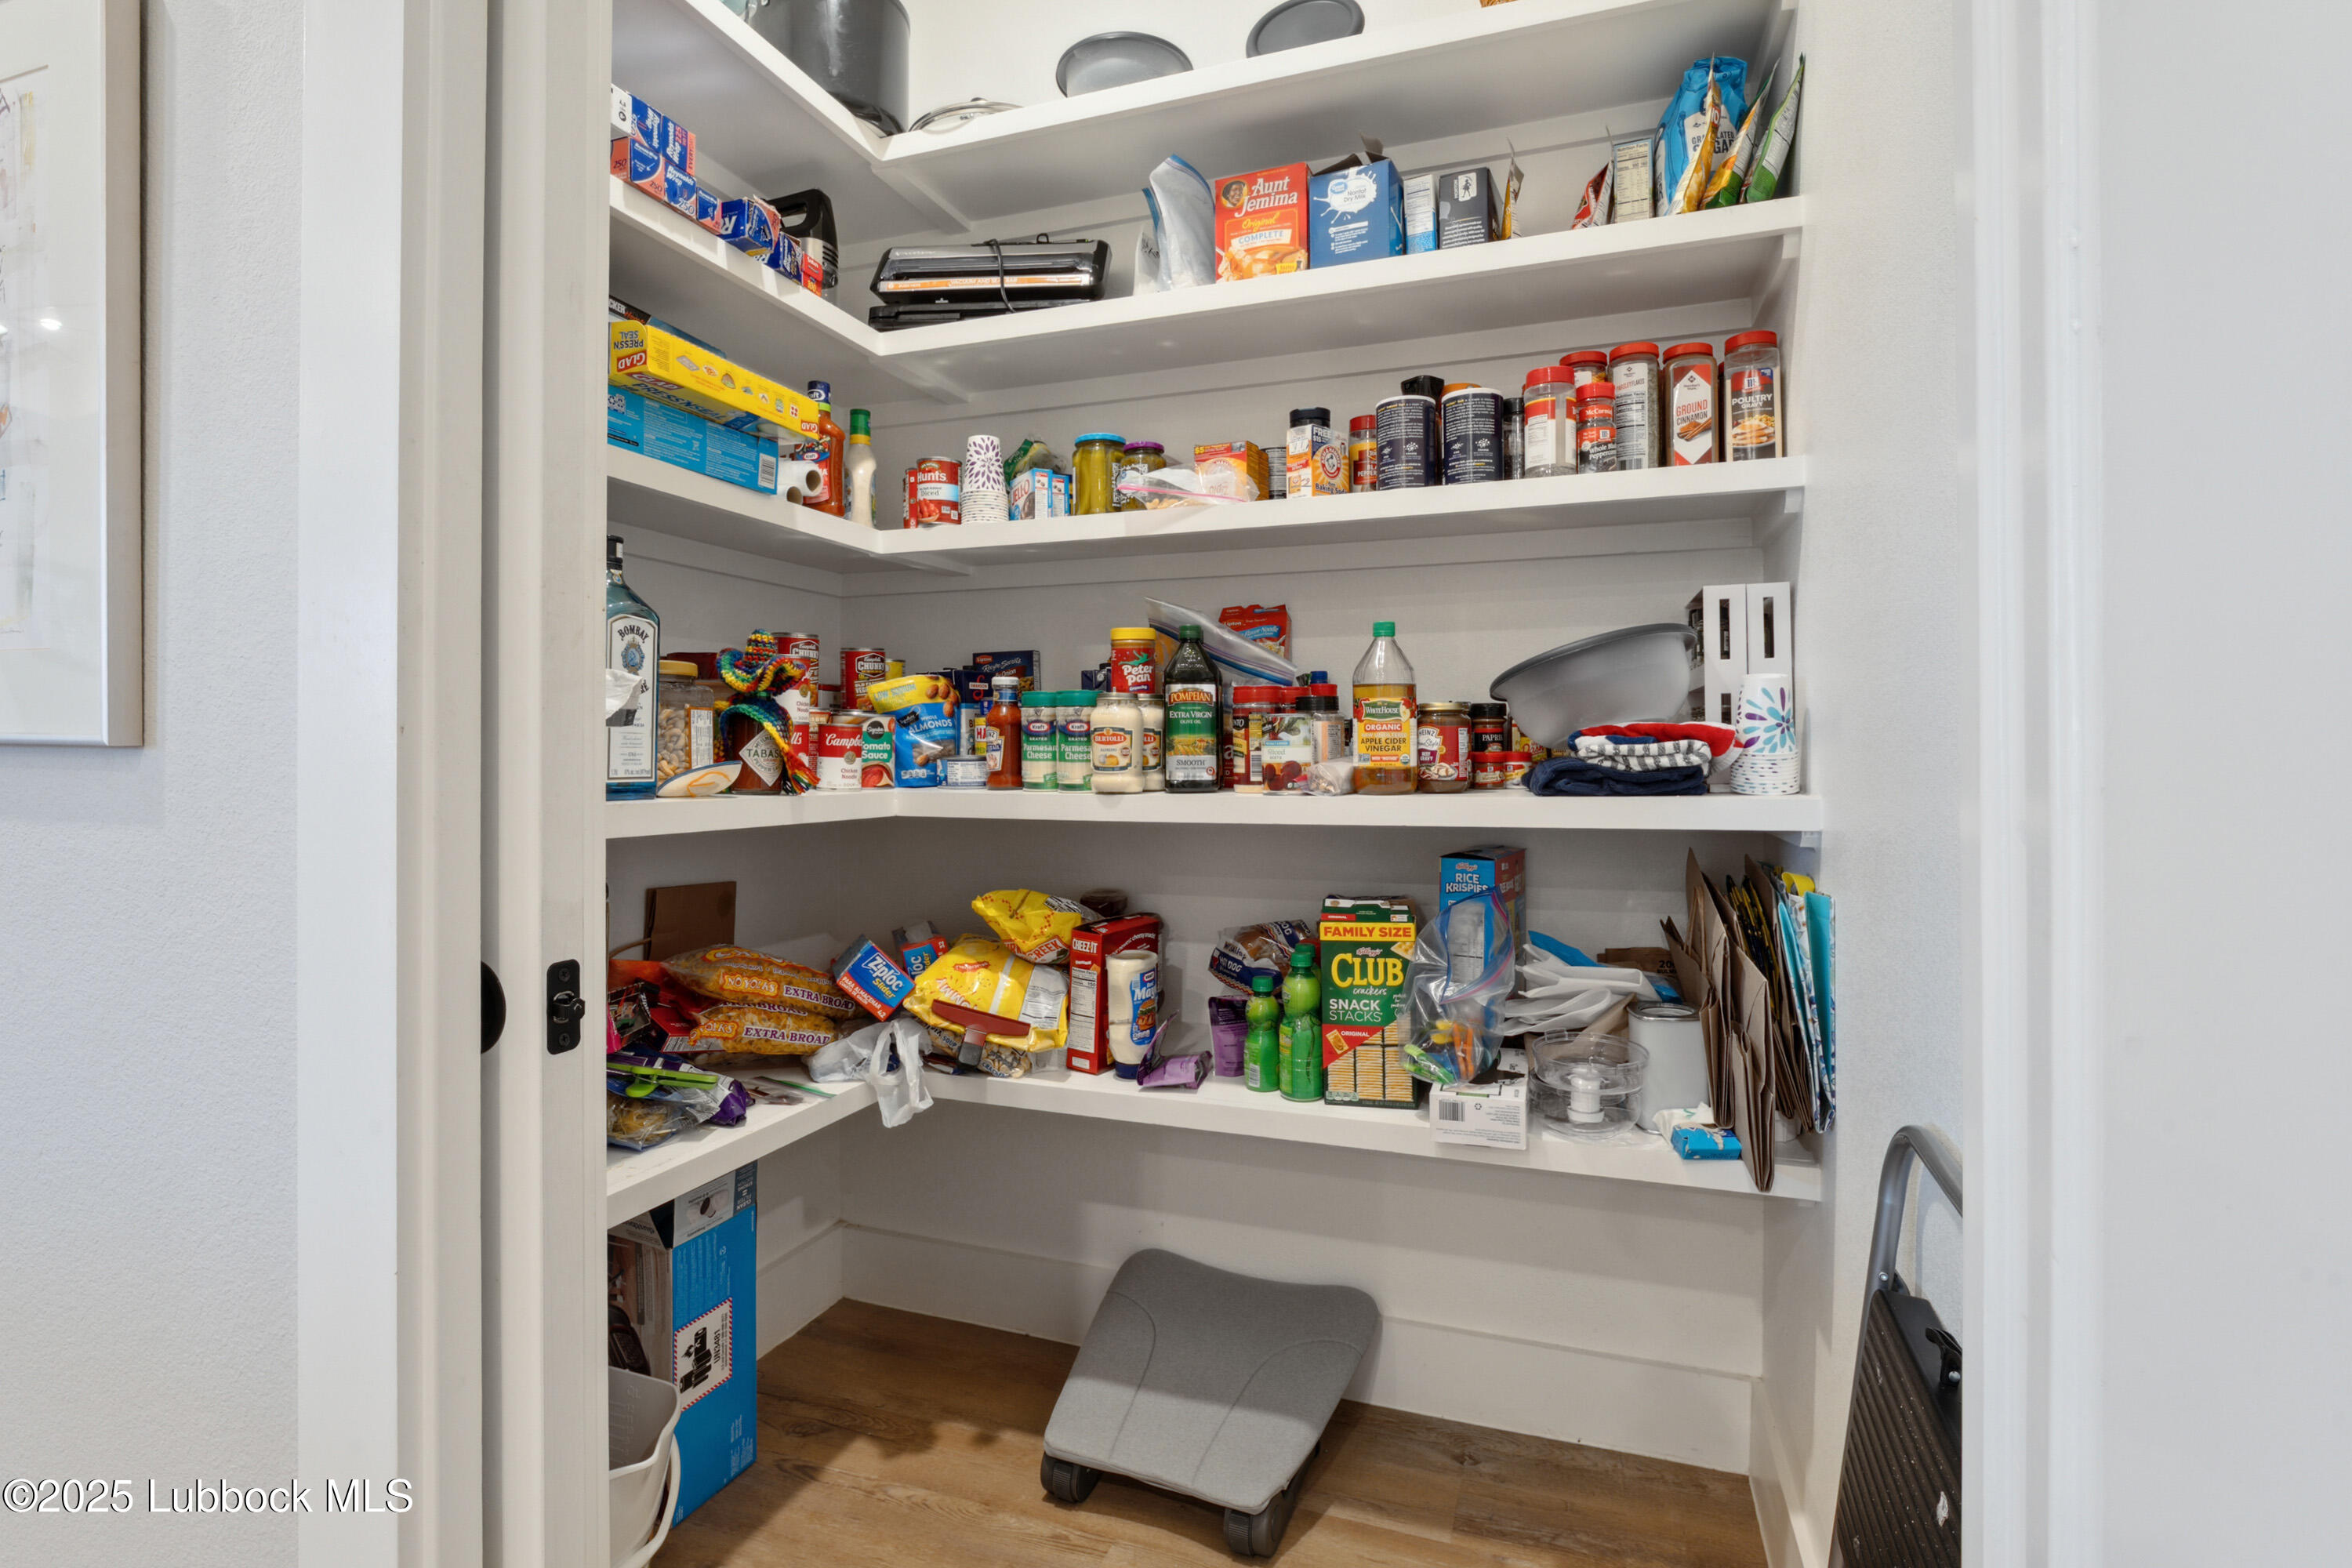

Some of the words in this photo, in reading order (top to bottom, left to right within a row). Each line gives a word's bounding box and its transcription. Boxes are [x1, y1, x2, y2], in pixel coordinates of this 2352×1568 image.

[613, 158, 627, 170] 250
[666, 171, 684, 187] Wrap
[667, 165, 695, 186] Reynolds
[1252, 176, 1290, 196] Aunt
[677, 198, 695, 216] 250
[1235, 191, 1298, 217] Jemima
[1242, 212, 1280, 232] Original
[1238, 230, 1284, 245] COMPLETE
[619, 331, 638, 340] SEAL
[618, 352, 646, 369] GLAD
[632, 373, 679, 390] GLAD
[1731, 394, 1773, 406] POULTRY
[1740, 401, 1764, 409] GRAVY
[1676, 399, 1708, 417] GROUND
[1676, 410, 1708, 426] CINNAMON
[801, 422, 818, 432] GLAD
[1588, 443, 1607, 454] Whole
[1011, 478, 1030, 506] JELL-O
[1315, 482, 1334, 495] Baking
[617, 624, 650, 643] BOMBAY
[1122, 664, 1153, 676] Peter
[1126, 673, 1152, 686] Pan
[874, 690, 889, 702] LOW
[1171, 691, 1211, 702] POMPEIAN
[909, 718, 953, 734] ALMONDS
[1094, 734, 1125, 742] BERTOLLI
[746, 749, 781, 759] TABAS
[862, 750, 888, 760] Sauce
[1026, 750, 1053, 760] Cheese
[1455, 862, 1478, 872] Kellogg's
[1455, 873, 1480, 884] RICE
[1446, 882, 1489, 894] KRISPIES
[1323, 926, 1376, 937] FAMILY
[1378, 927, 1412, 938] SIZE
[1027, 939, 1062, 963] CREEK
[1356, 946, 1383, 956] Kellogg's
[1227, 960, 1243, 972] DOG
[1330, 953, 1404, 988] CLUB
[867, 955, 904, 992] Ziploc
[727, 976, 742, 987] NO
[744, 978, 776, 993] YOLKS
[872, 978, 896, 999] Slider
[1352, 985, 1388, 996] crackers
[784, 985, 819, 1002] EXTRA
[822, 995, 855, 1011] BROAD
[841, 976, 855, 989] PARA
[854, 985, 882, 1010] ALMACENAR
[1134, 985, 1156, 1001] May
[1329, 998, 1381, 1011] SNACK
[877, 1009, 887, 1018] 42
[1329, 1010, 1382, 1022] STACKS
[744, 1027, 785, 1040] EXTRA
[941, 1035, 958, 1047] SOUP
